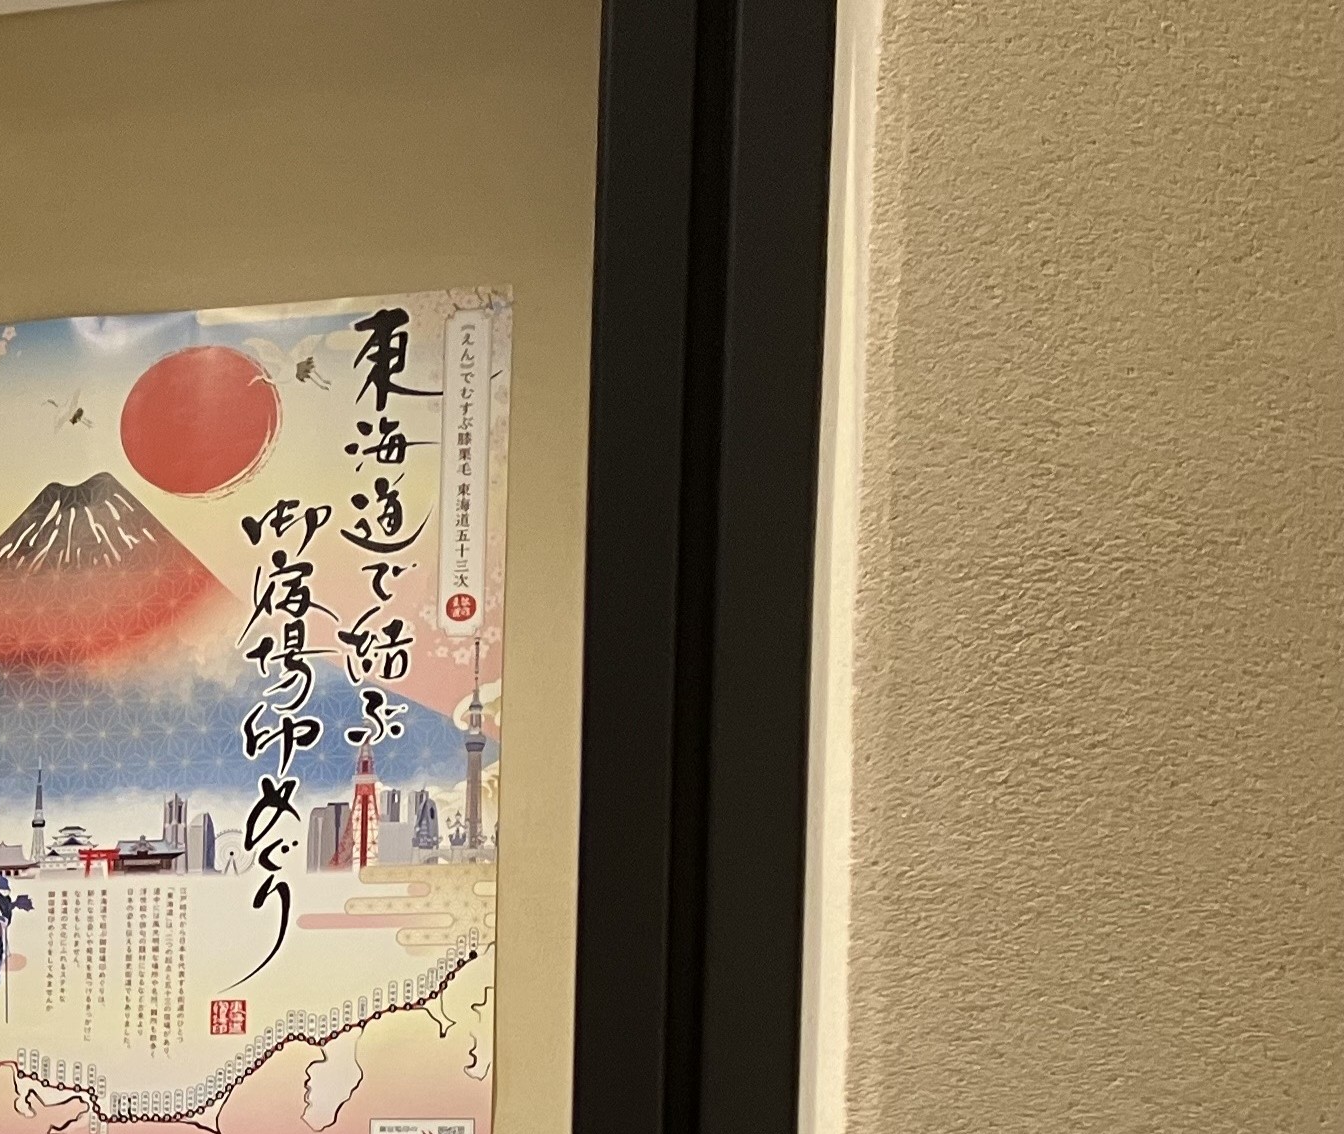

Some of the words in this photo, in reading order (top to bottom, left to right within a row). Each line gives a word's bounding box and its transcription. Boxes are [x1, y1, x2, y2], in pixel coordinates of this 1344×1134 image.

[218, 500, 342, 994] 御宿場印めぐり
[339, 306, 443, 745] 東海道で結ぶ
